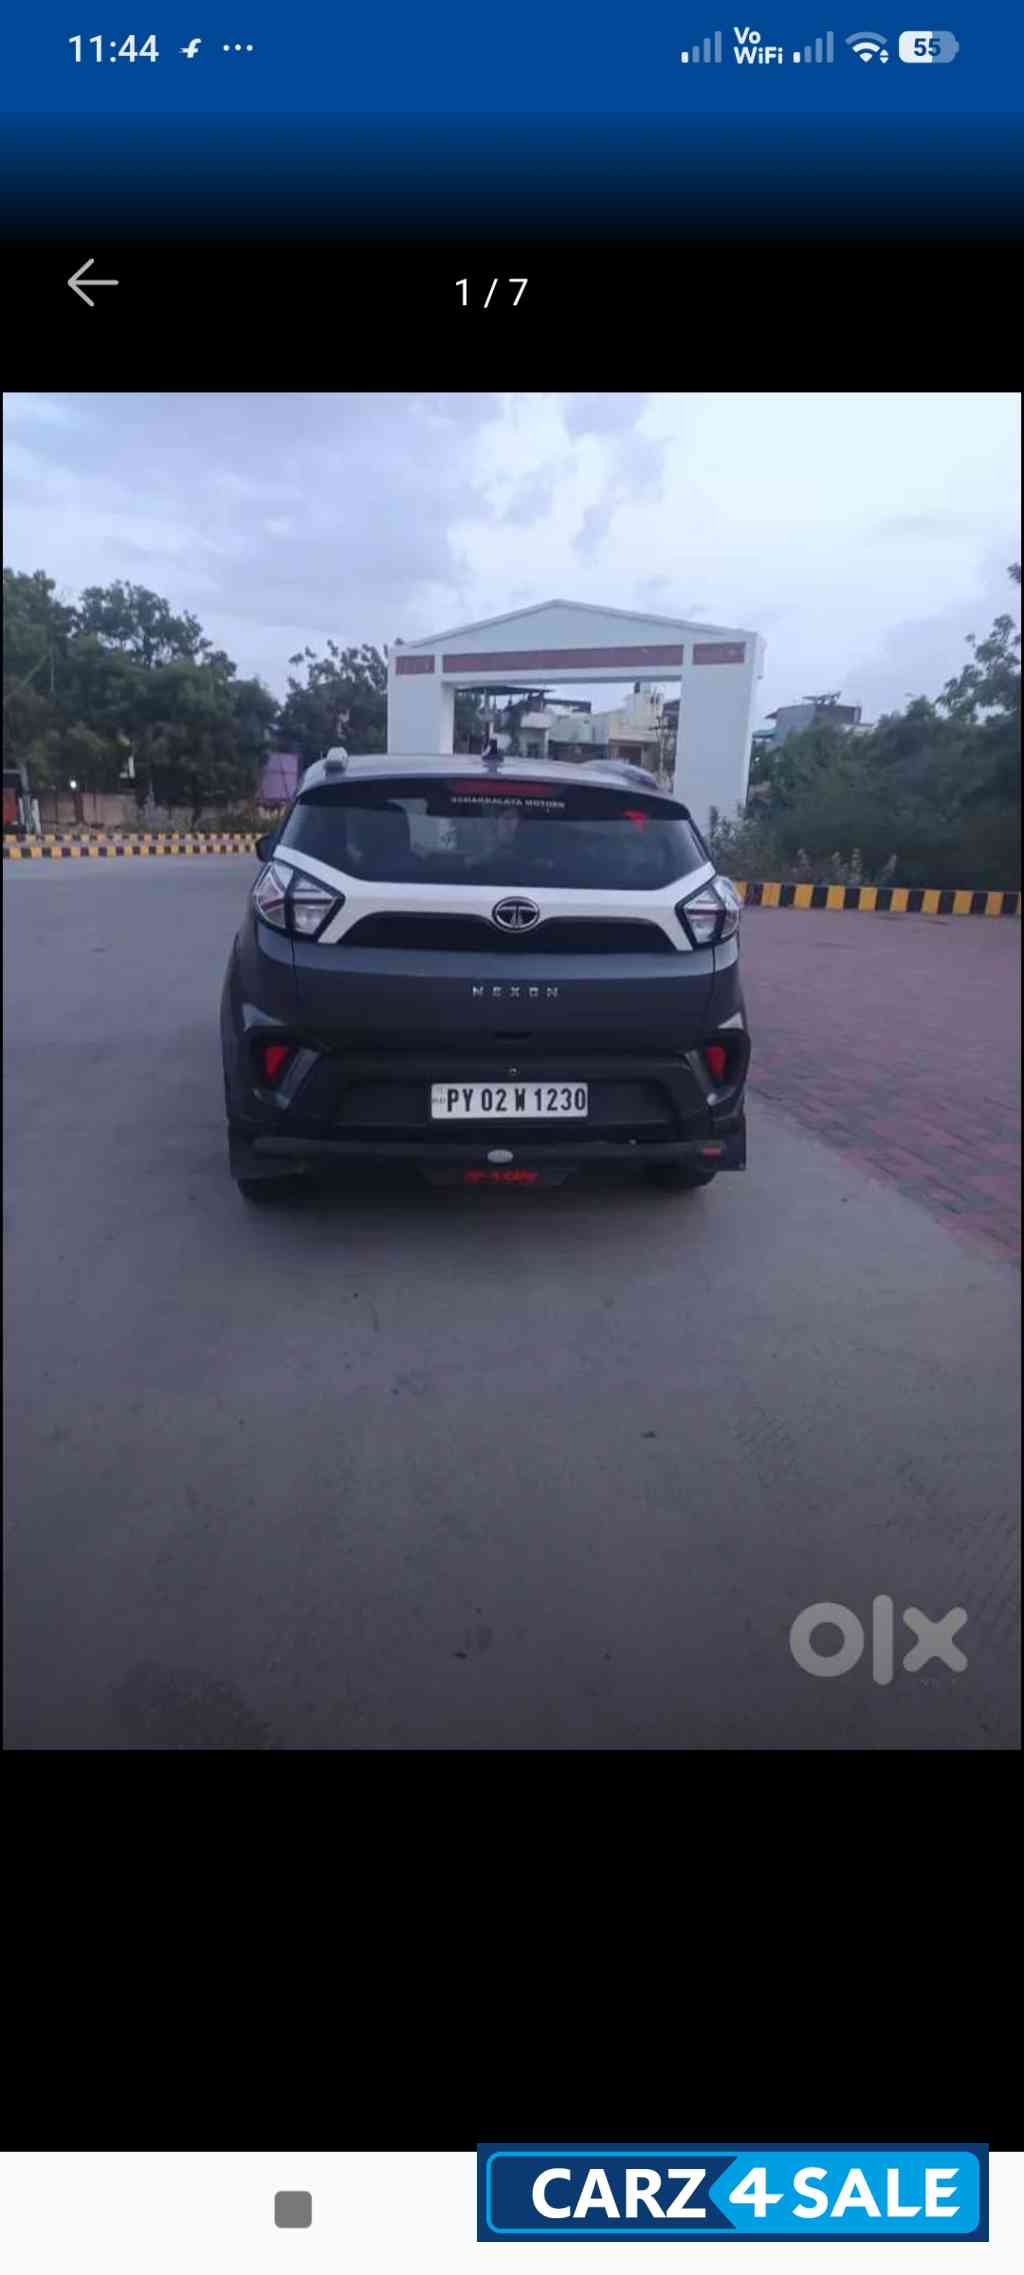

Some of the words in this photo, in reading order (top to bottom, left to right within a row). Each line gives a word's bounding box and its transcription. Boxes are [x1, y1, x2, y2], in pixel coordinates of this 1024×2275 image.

[734, 27, 761, 44] Vo
[68, 34, 160, 63] 11:44
[734, 46, 783, 64] WiFi
[913, 37, 942, 57] 55
[455, 278, 468, 306] 1
[508, 278, 528, 306] 7
[472, 985, 559, 998] NEXON
[447, 1088, 474, 1112] PY
[481, 1088, 507, 1112] 02
[514, 1088, 526, 1112] W
[534, 1088, 586, 1111] 1230
